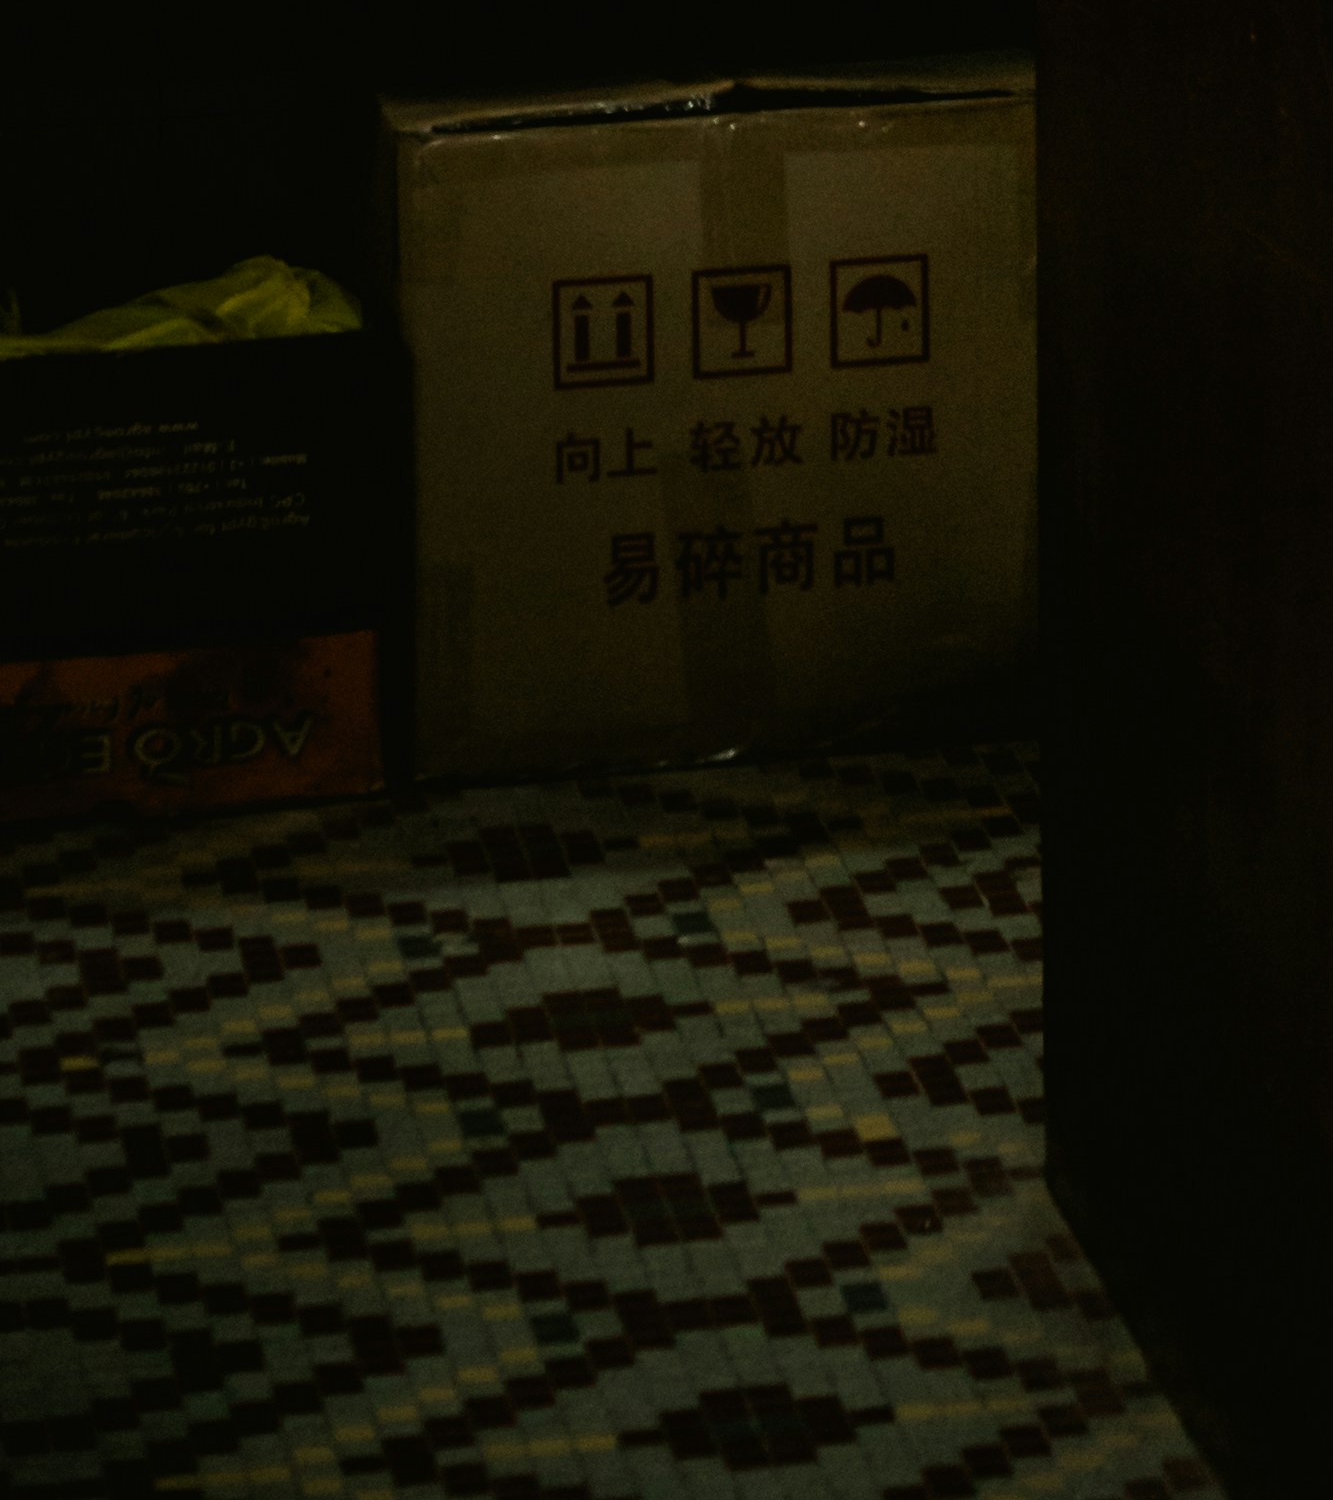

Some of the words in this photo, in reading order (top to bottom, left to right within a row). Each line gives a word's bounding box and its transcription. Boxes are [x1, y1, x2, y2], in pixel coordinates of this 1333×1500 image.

[554, 427, 659, 485] 向上
[689, 414, 804, 473] 轻放
[830, 404, 938, 462] 防湿
[602, 514, 897, 609] 易碎商品
